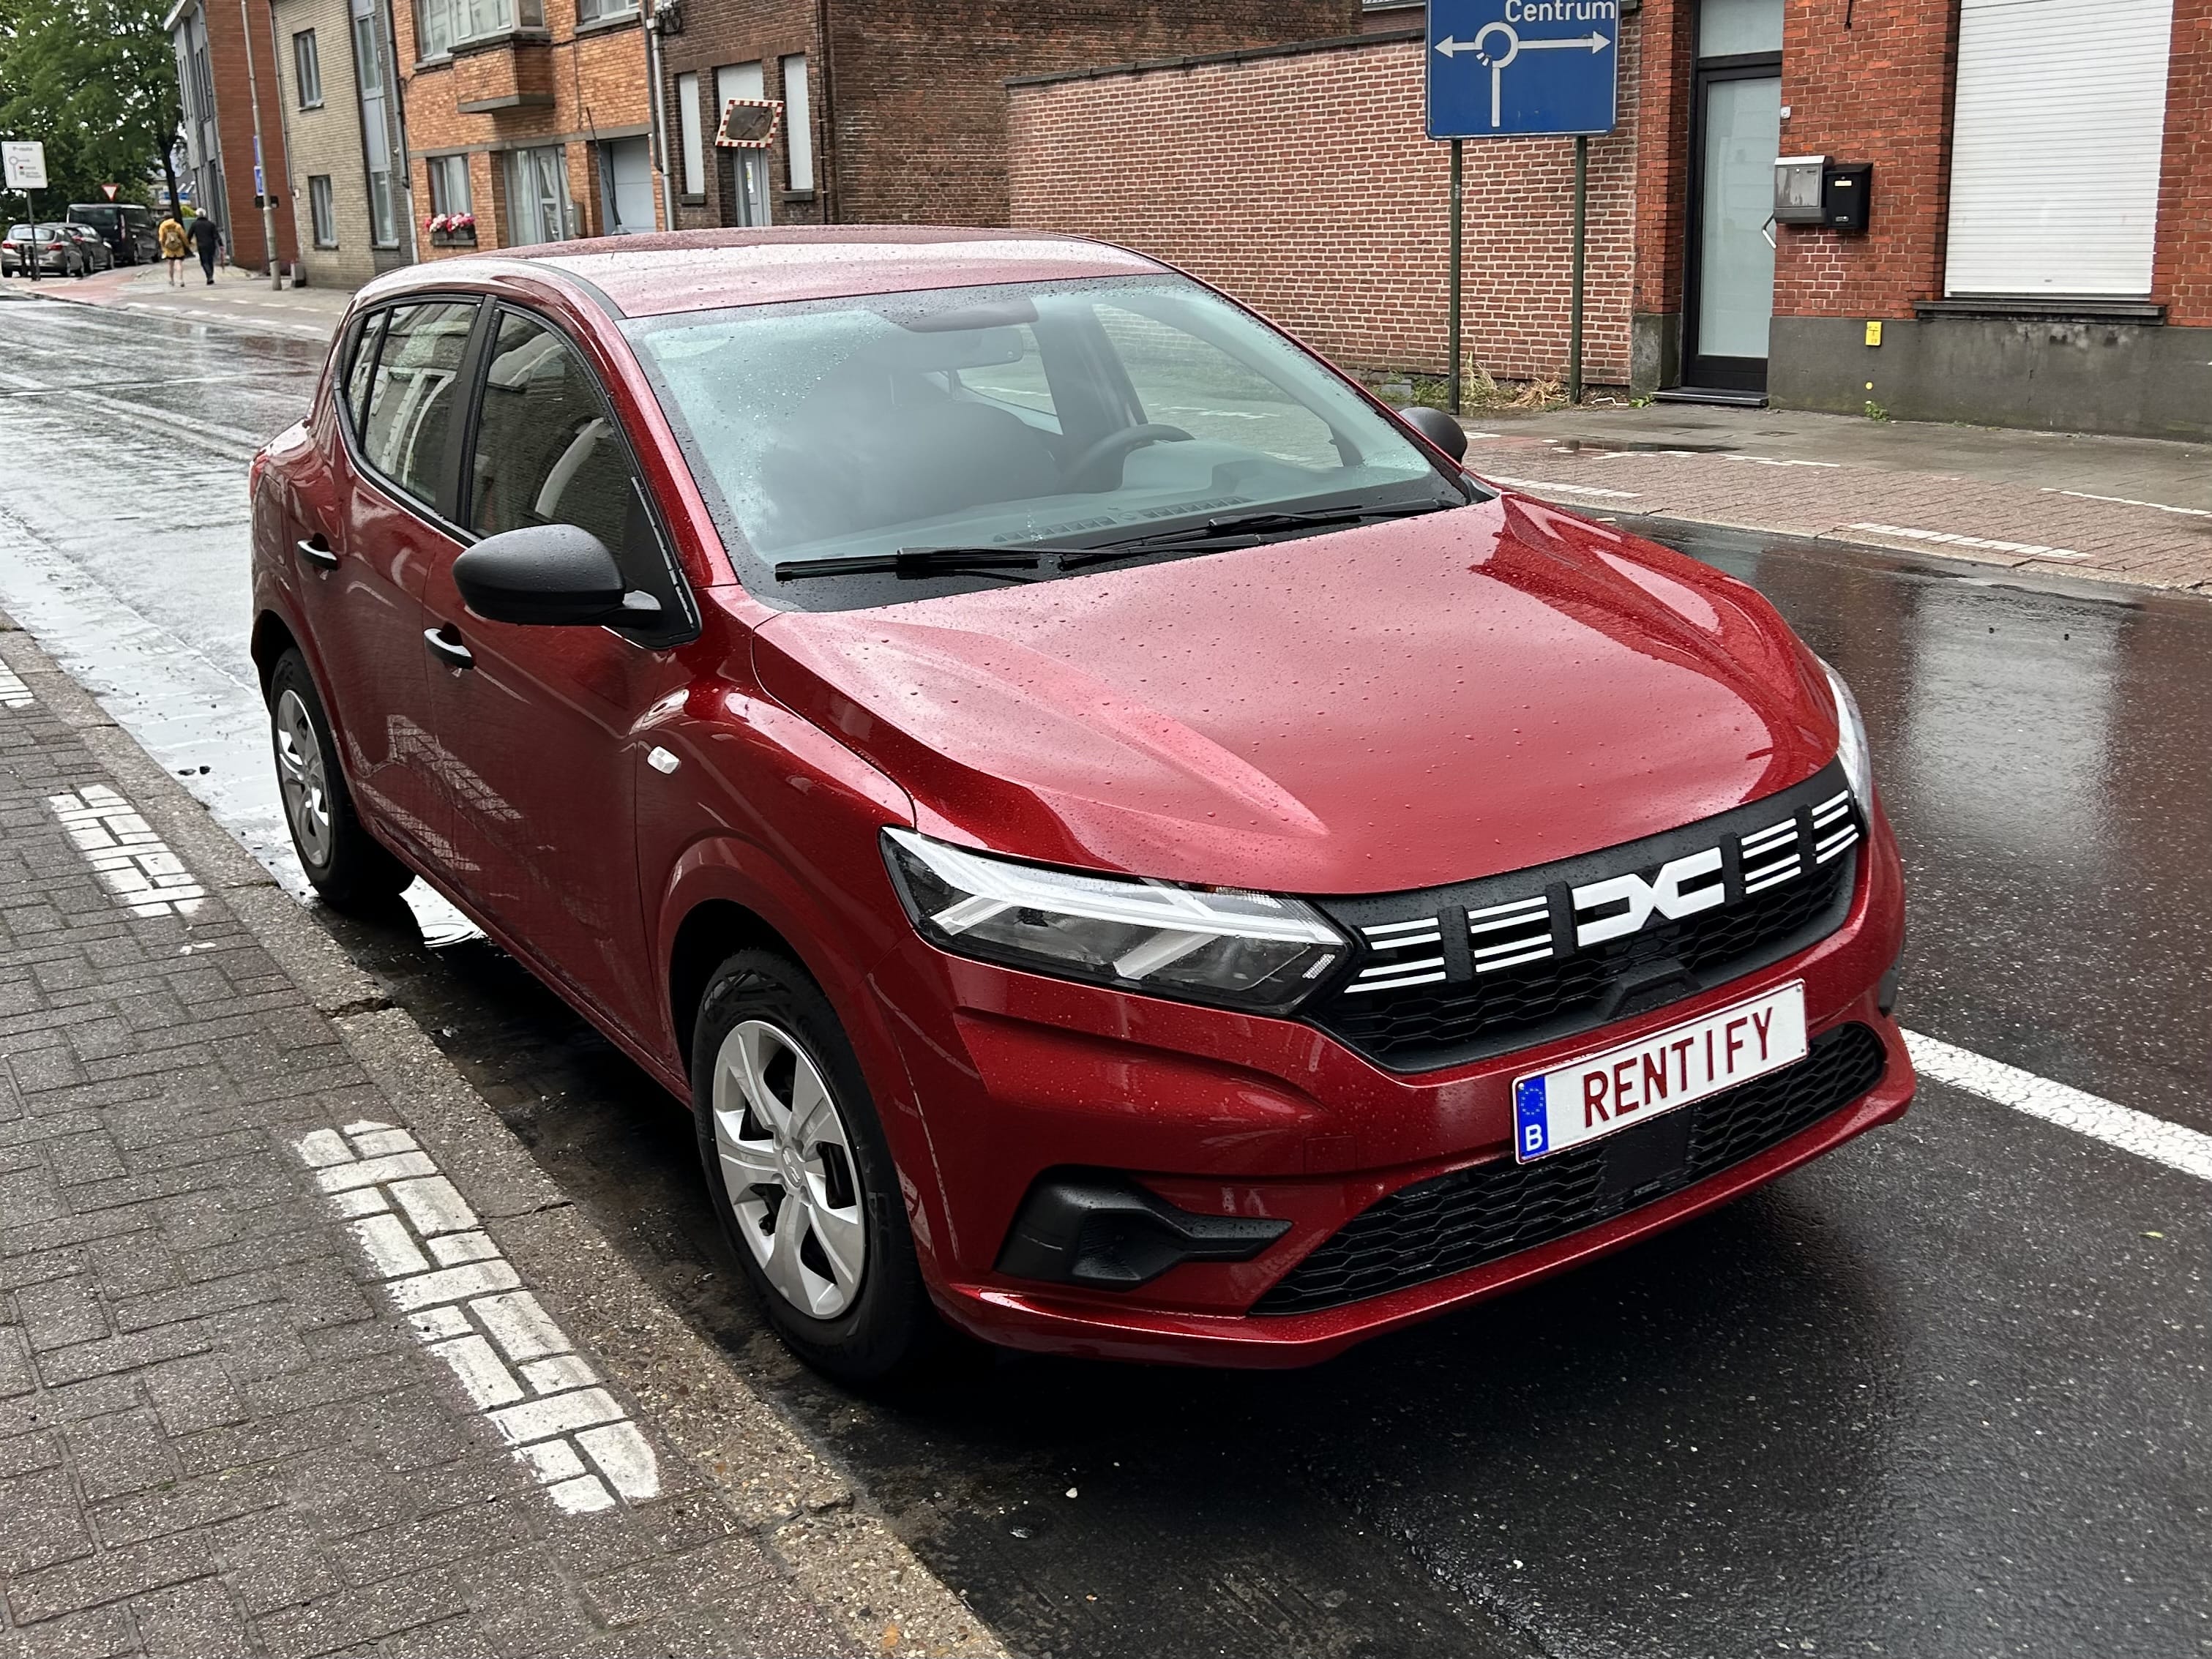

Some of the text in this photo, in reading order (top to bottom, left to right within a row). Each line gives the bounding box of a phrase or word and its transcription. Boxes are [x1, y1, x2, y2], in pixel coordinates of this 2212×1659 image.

[1505, 0, 1615, 23] Centrum
[1583, 1007, 1772, 1128] RENTIFY
[1525, 1124, 1543, 1151] B
